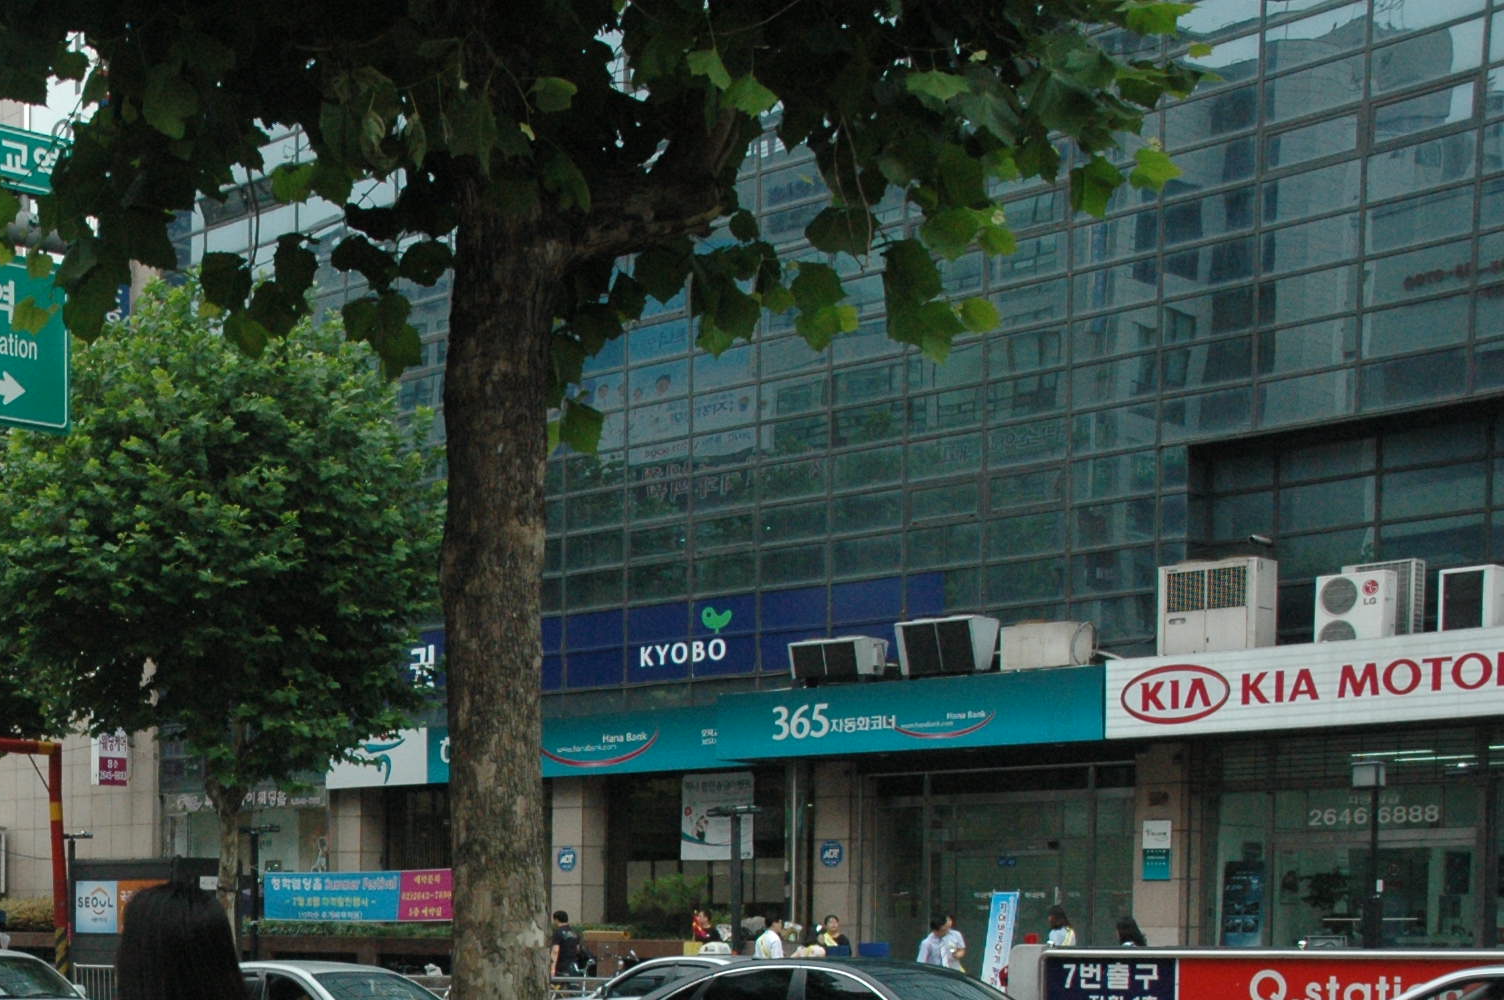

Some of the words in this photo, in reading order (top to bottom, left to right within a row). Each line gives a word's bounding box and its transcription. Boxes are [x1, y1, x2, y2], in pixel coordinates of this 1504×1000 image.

[1362, 598, 1378, 606] LG
[639, 638, 727, 669] KYOBO
[1141, 677, 1212, 712] KIA
[1240, 668, 1320, 706] KIA
[772, 703, 830, 741] 365
[831, 714, 896, 733] 자동화코너
[602, 733, 625, 744] Hana
[626, 731, 648, 742] Bank
[1309, 807, 1369, 827] 2646
[1378, 804, 1441, 824] 6888
[77, 897, 114, 909] SEOUL
[1062, 962, 1159, 990] 7번출구
